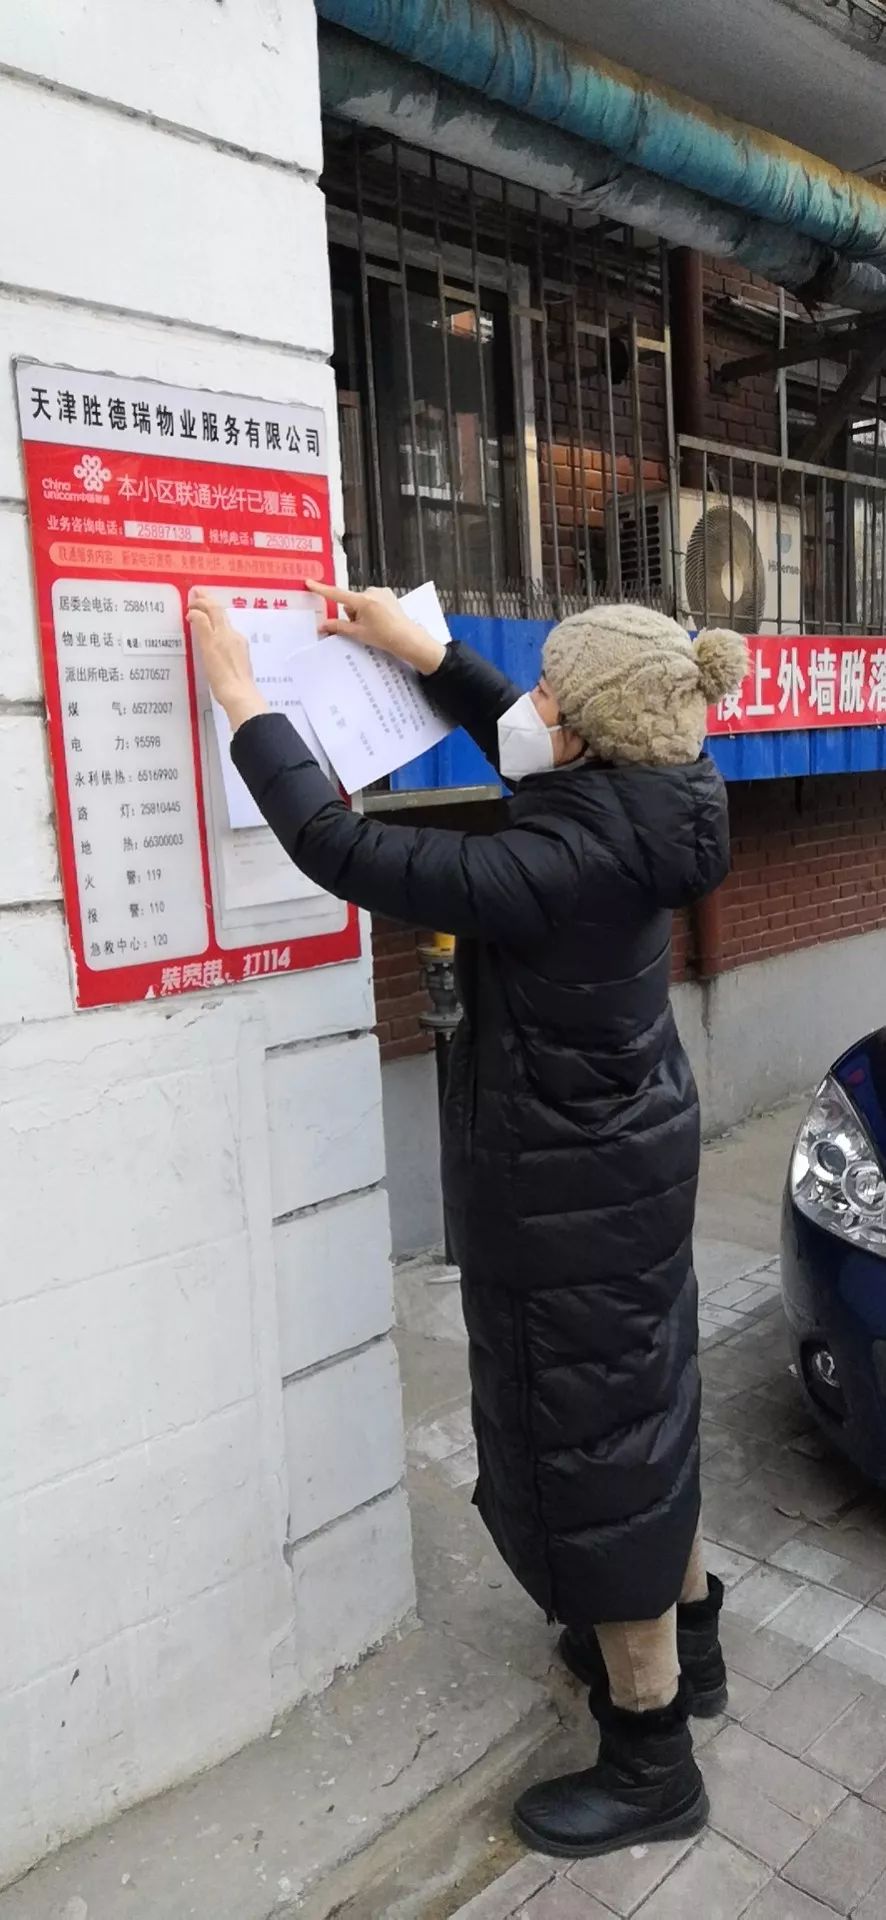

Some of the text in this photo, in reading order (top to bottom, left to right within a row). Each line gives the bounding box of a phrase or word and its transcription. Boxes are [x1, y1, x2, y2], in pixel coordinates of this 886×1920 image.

[30, 387, 321, 457] 天津胜德瑞物业服务有限公司
[42, 478, 71, 491] China
[117, 474, 297, 517] 本小区联通光纤已覆盖
[768, 560, 801, 575] Hiense
